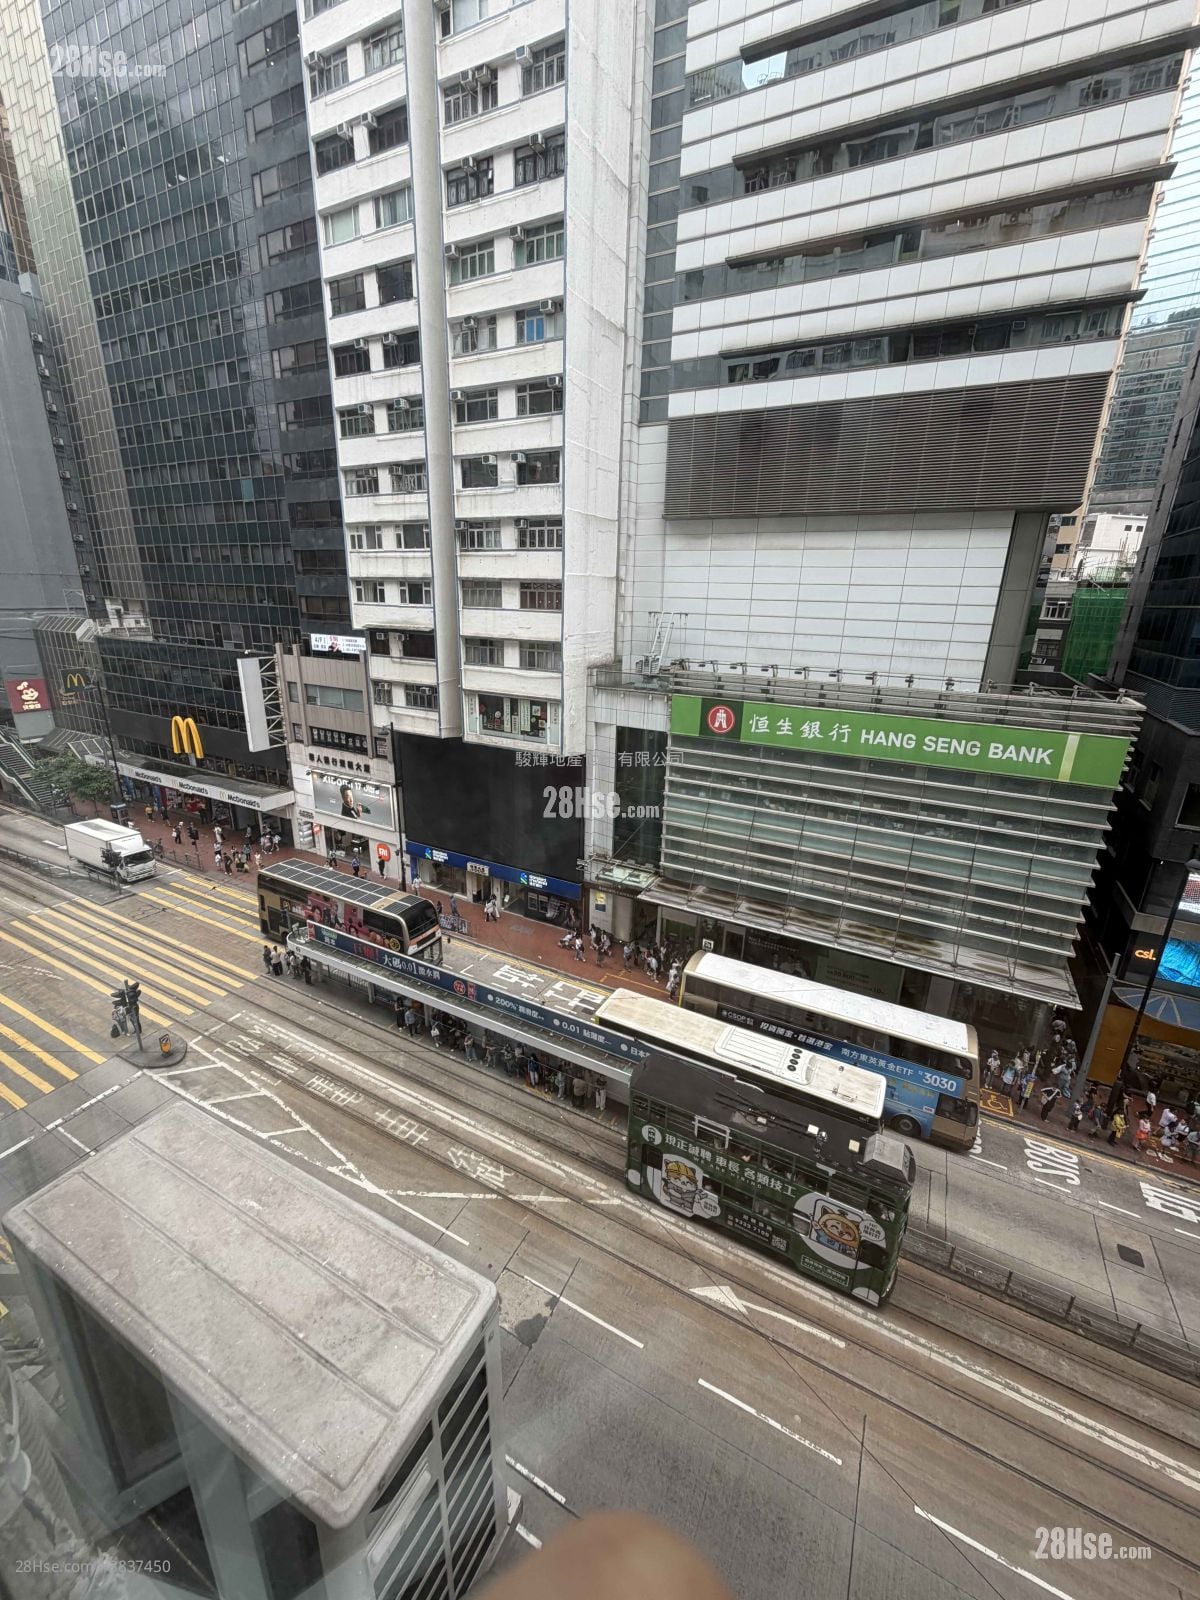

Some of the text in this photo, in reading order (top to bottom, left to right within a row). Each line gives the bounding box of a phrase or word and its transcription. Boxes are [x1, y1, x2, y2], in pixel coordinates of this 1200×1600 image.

[749, 713, 1054, 765] 恒生銀行 HANG SENG BANK
[178, 781, 208, 795] McDonald's
[227, 794, 261, 808] McDonald's
[562, 1023, 580, 1034] 0.01
[922, 1072, 957, 1092] 3030
[1024, 1137, 1080, 1185] BUS
